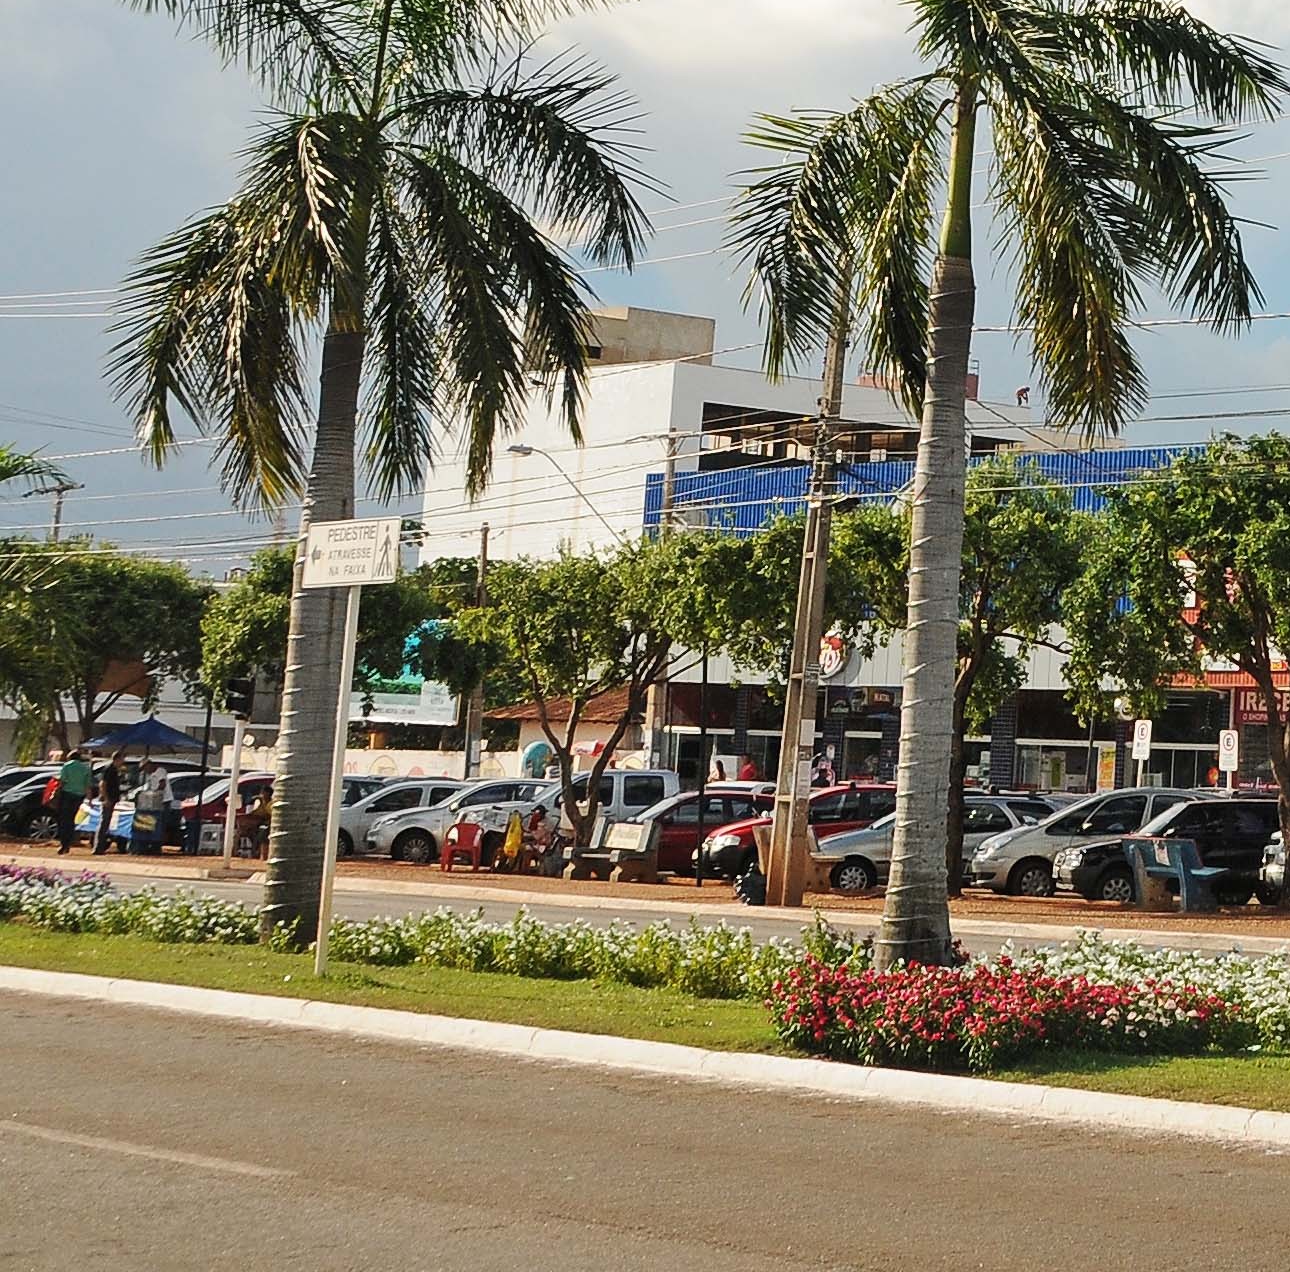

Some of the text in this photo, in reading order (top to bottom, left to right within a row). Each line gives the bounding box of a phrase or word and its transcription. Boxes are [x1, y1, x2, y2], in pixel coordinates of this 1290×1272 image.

[328, 525, 377, 542] PEDESTRE
[327, 548, 372, 561] ATRAVESSE
[328, 567, 339, 577] NA
